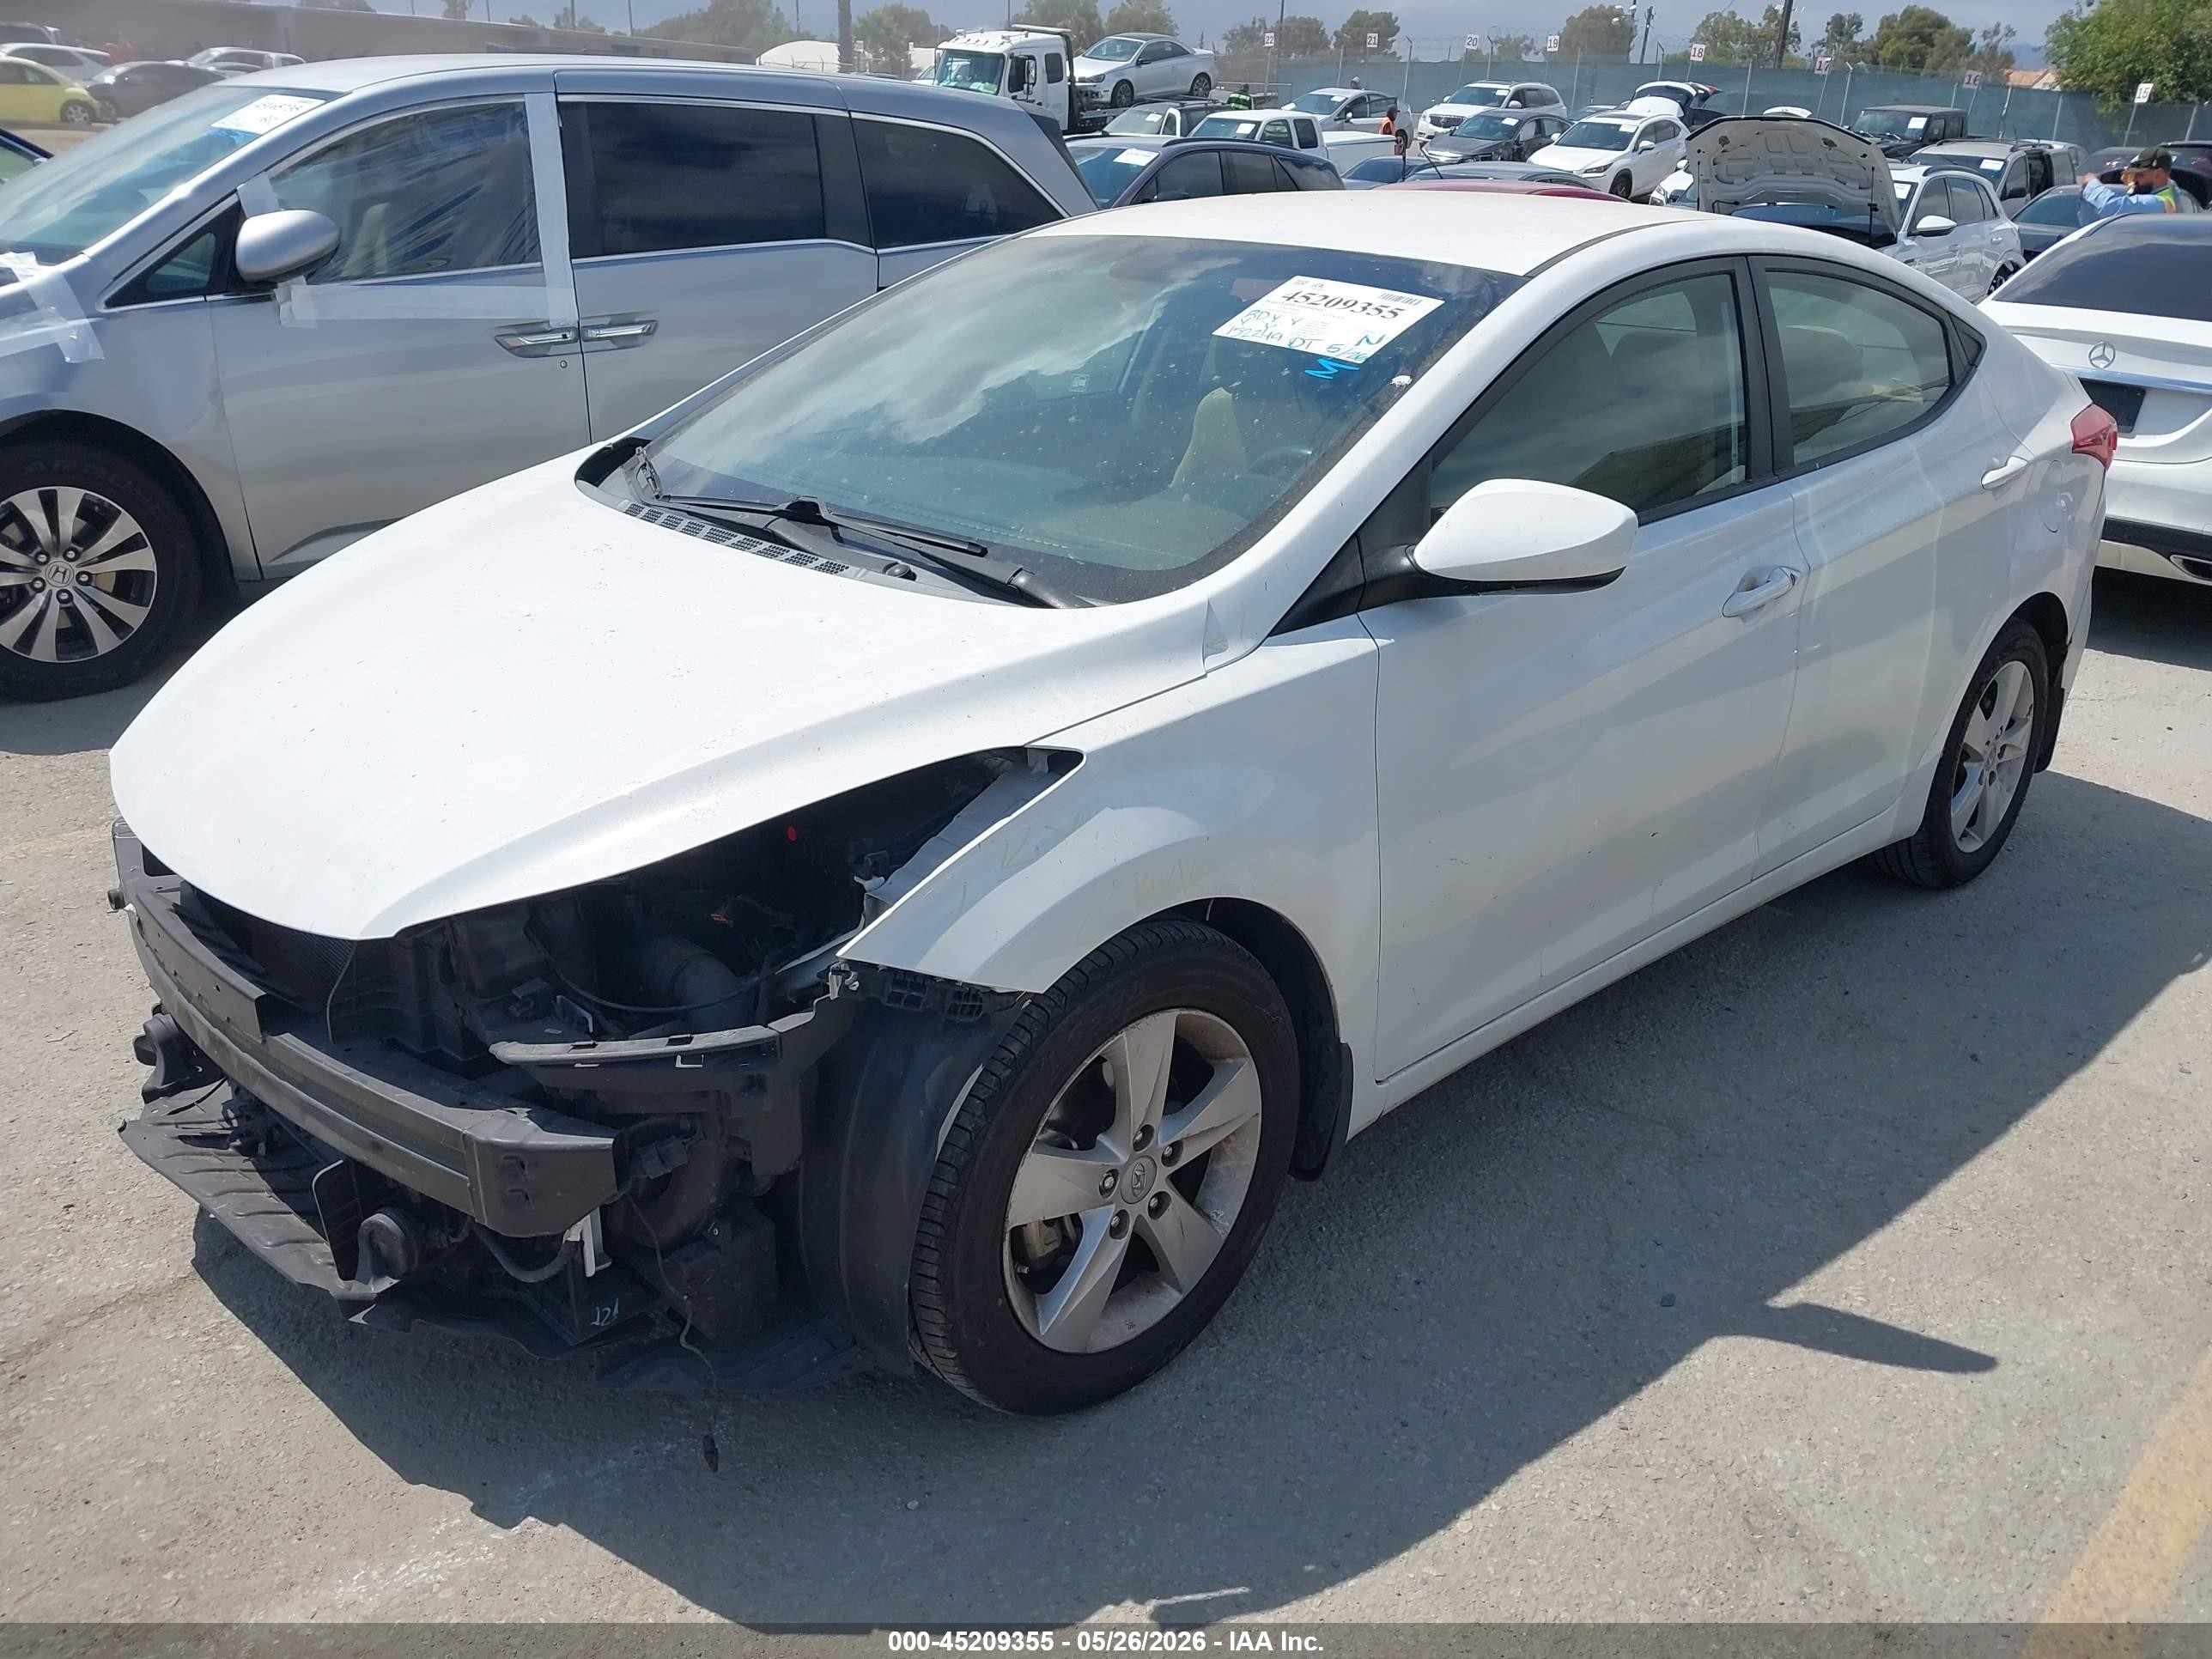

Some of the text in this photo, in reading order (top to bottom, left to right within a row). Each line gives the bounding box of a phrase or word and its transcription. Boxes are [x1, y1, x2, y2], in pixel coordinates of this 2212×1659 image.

[1265, 35, 1274, 44] 22
[1367, 35, 1378, 46] 21
[1466, 36, 1478, 47] 20
[1547, 38, 1559, 49] 19
[1691, 46, 1704, 58] 18
[1816, 60, 1830, 71] 17
[1965, 73, 1980, 85] 16
[2136, 88, 2149, 100] 15
[1282, 290, 1405, 319] 45209355
